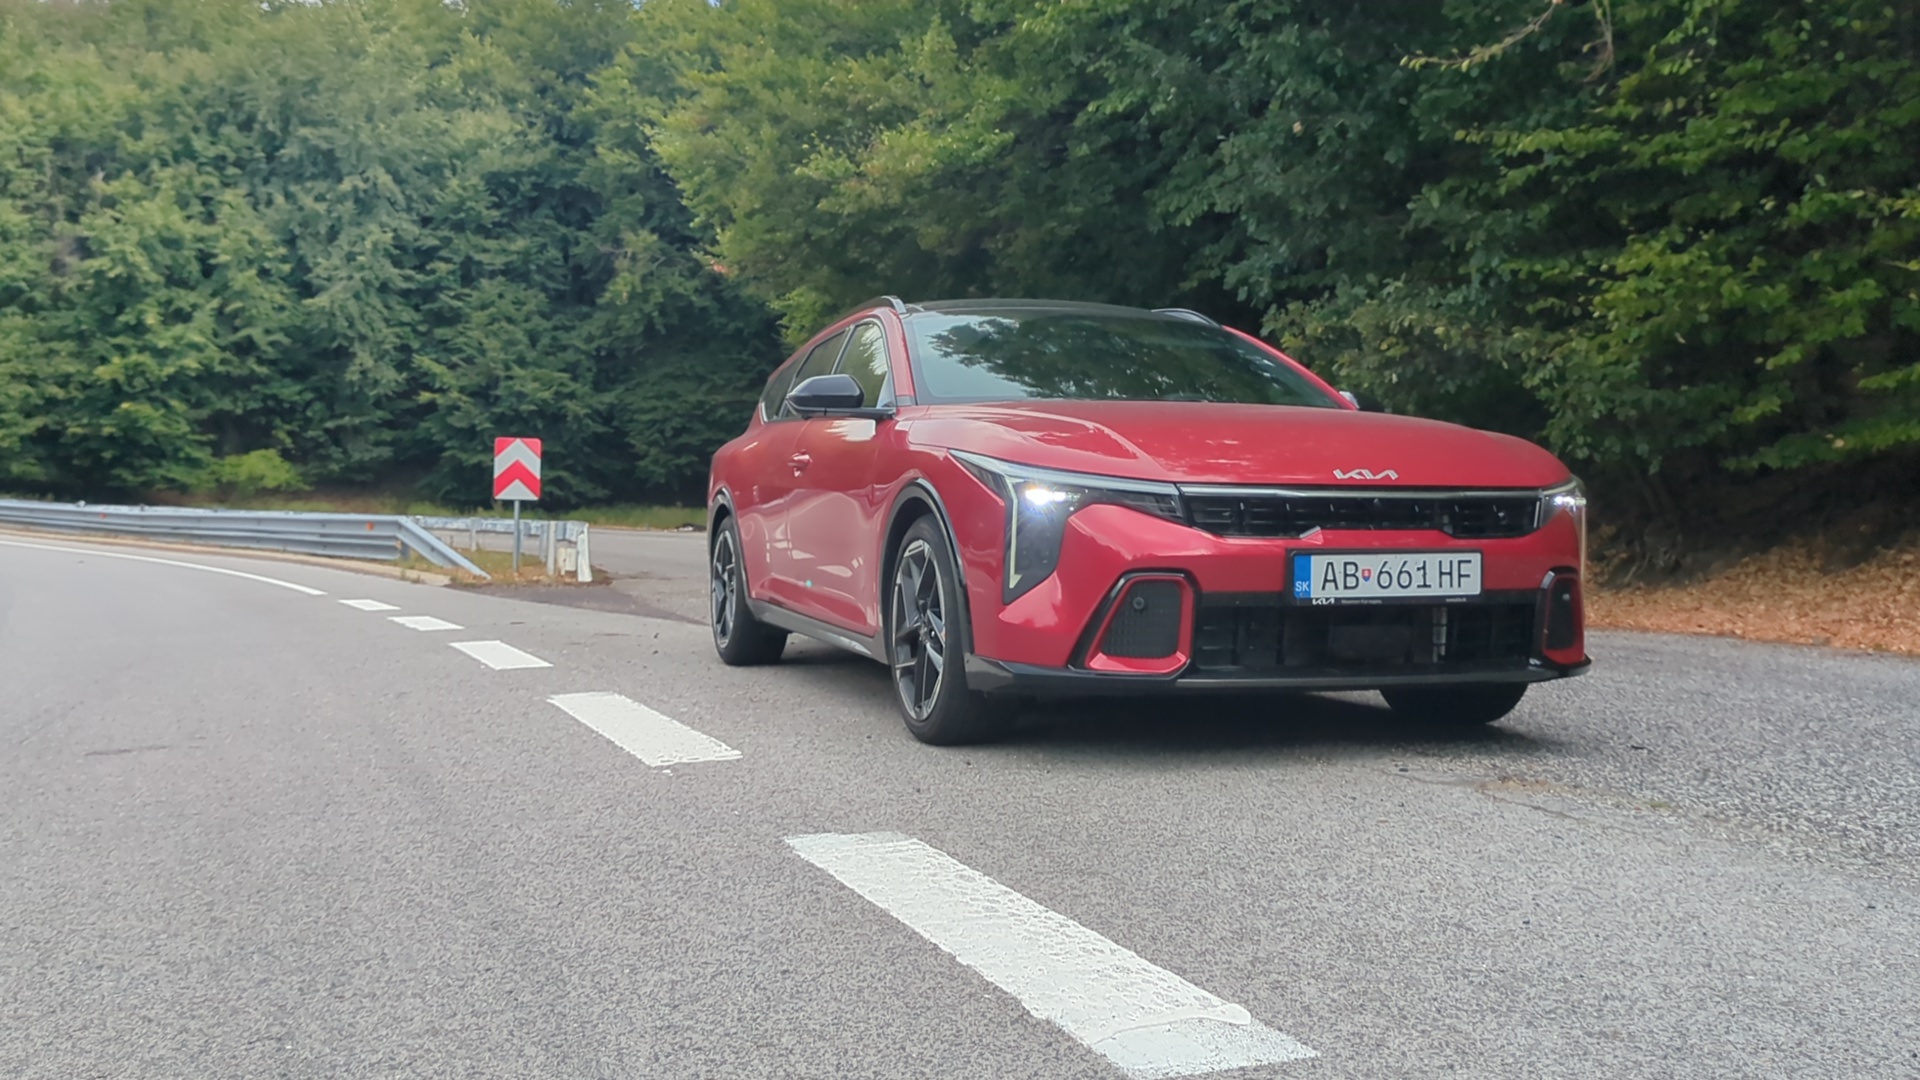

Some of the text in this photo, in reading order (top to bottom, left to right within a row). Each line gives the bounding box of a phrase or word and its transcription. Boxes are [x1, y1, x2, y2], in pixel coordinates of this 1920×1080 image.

[1333, 468, 1399, 480] KIA
[1321, 561, 1360, 591] AB
[1295, 581, 1310, 592] SK
